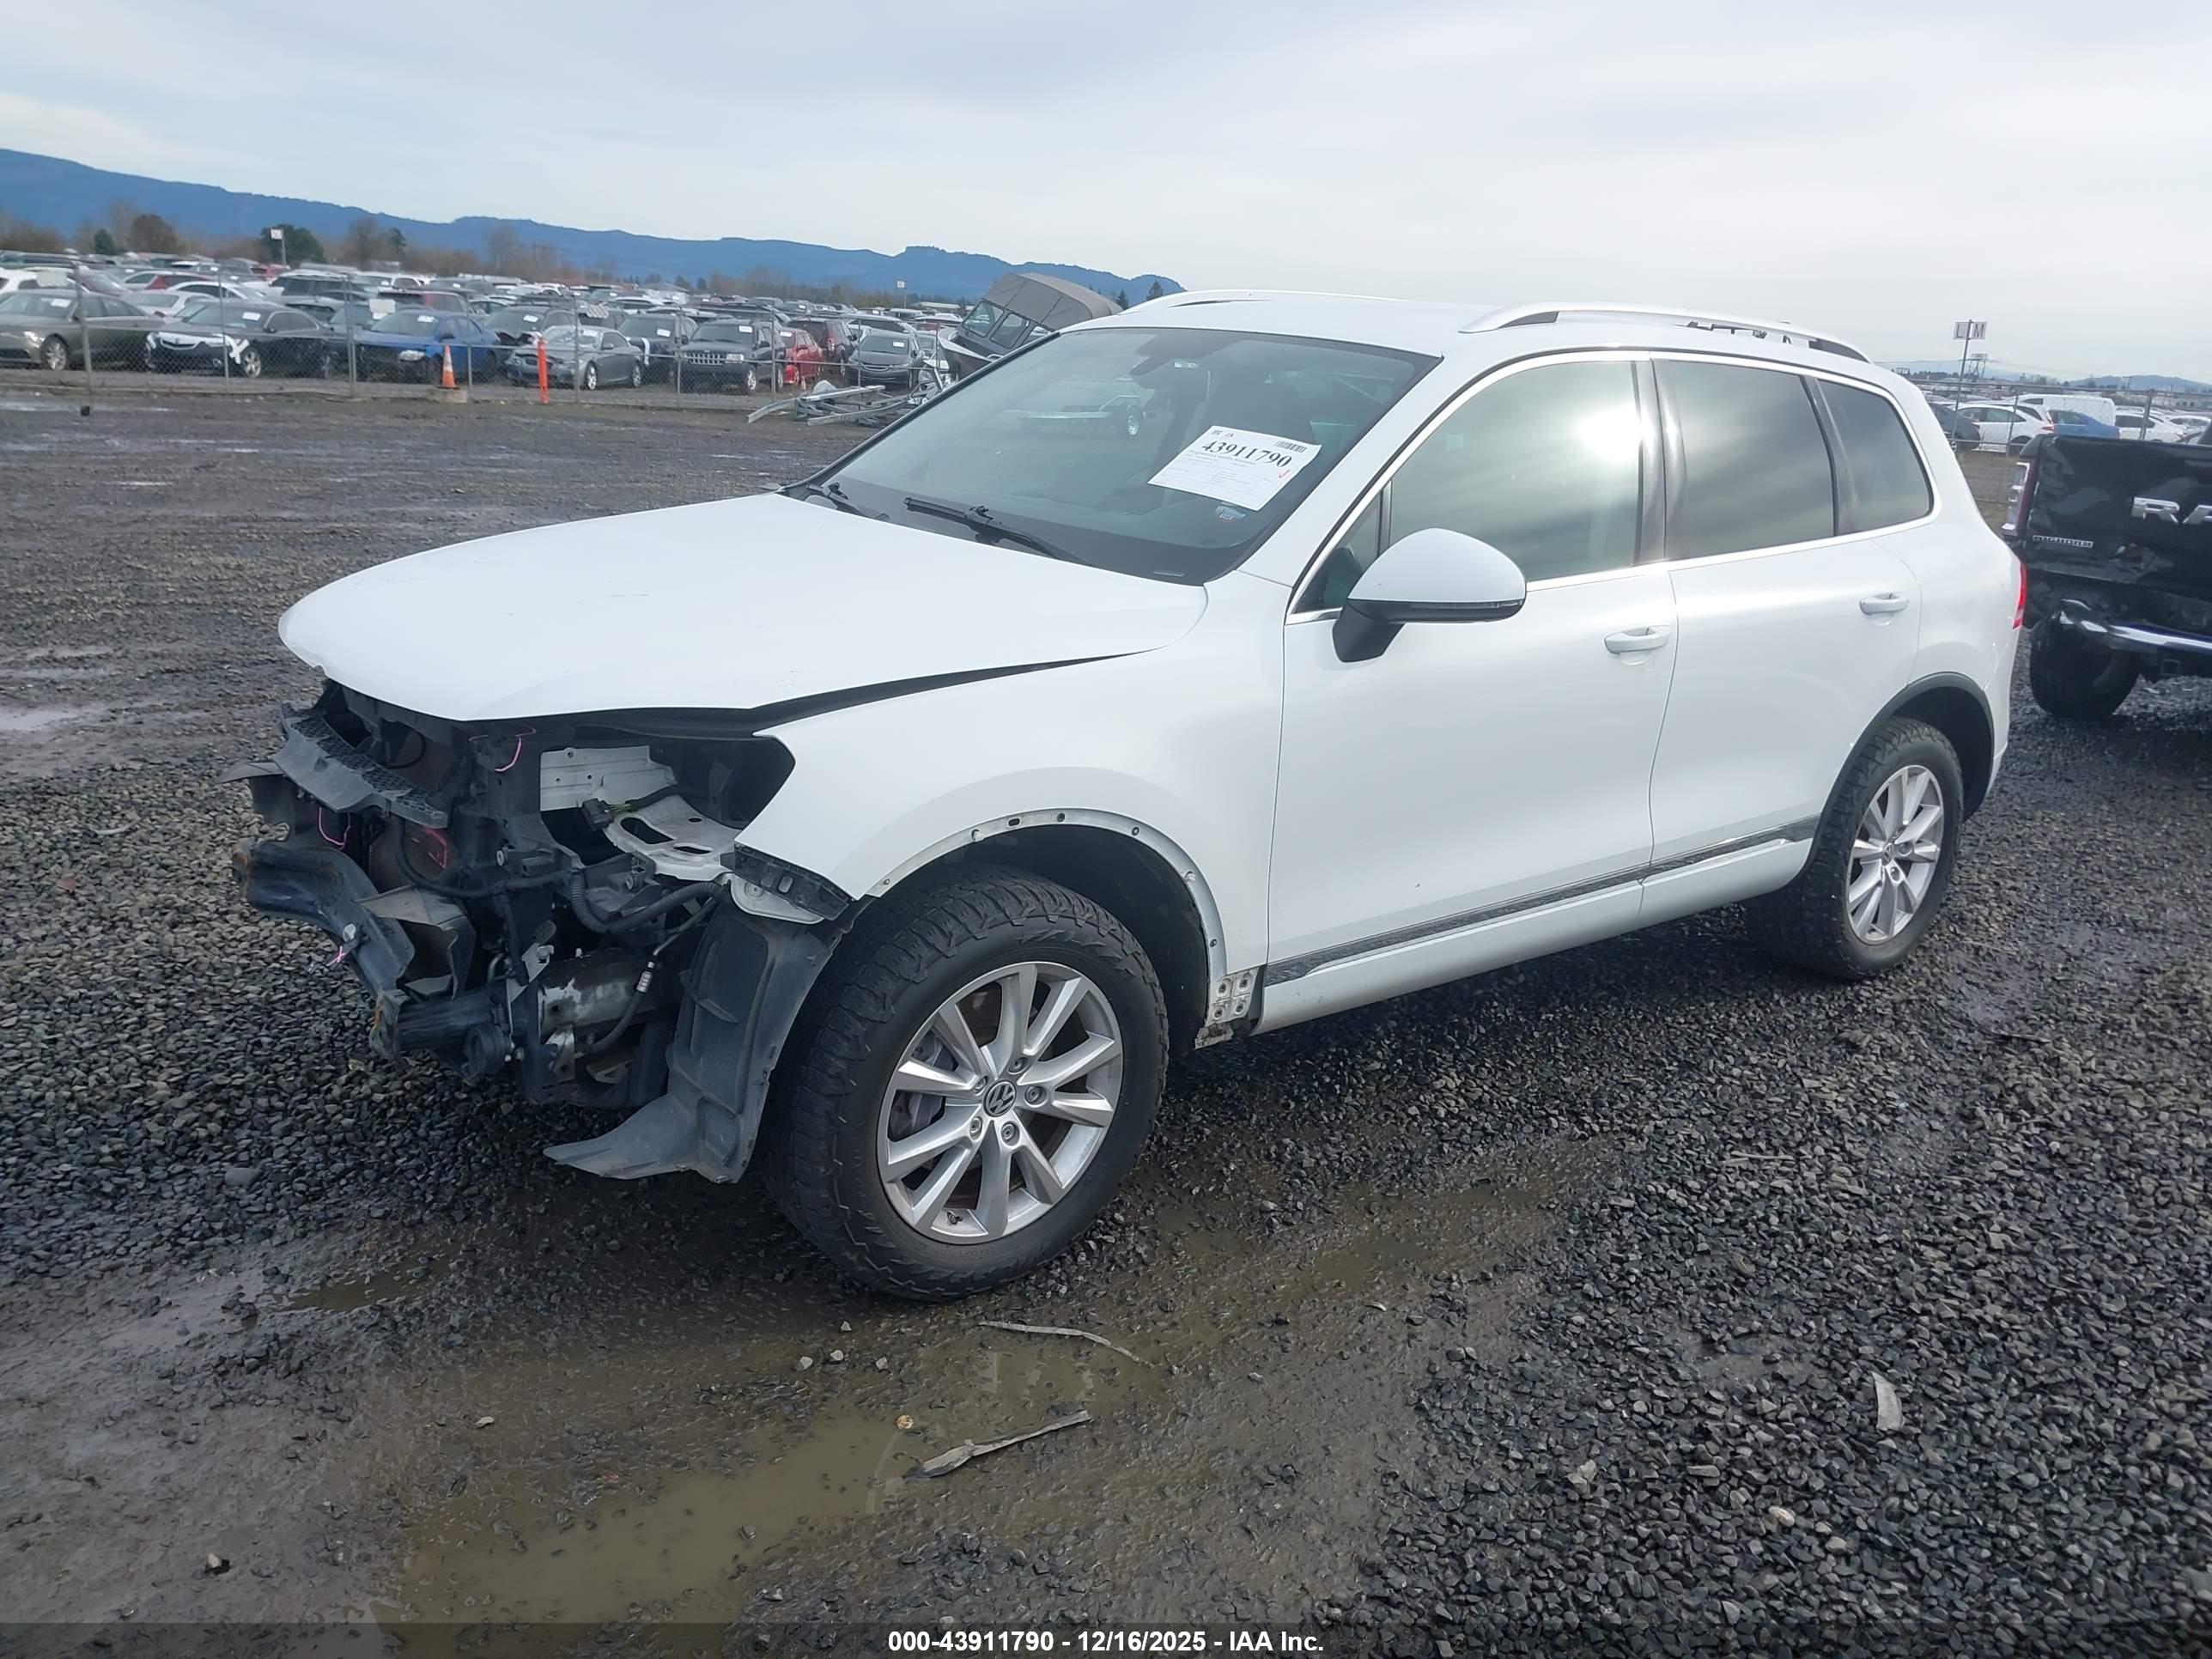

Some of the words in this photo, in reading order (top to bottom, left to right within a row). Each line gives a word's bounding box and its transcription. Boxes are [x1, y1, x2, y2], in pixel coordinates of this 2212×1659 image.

[1955, 323, 1965, 338] L
[1973, 323, 1984, 337] M
[1201, 440, 1293, 468] 43911790
